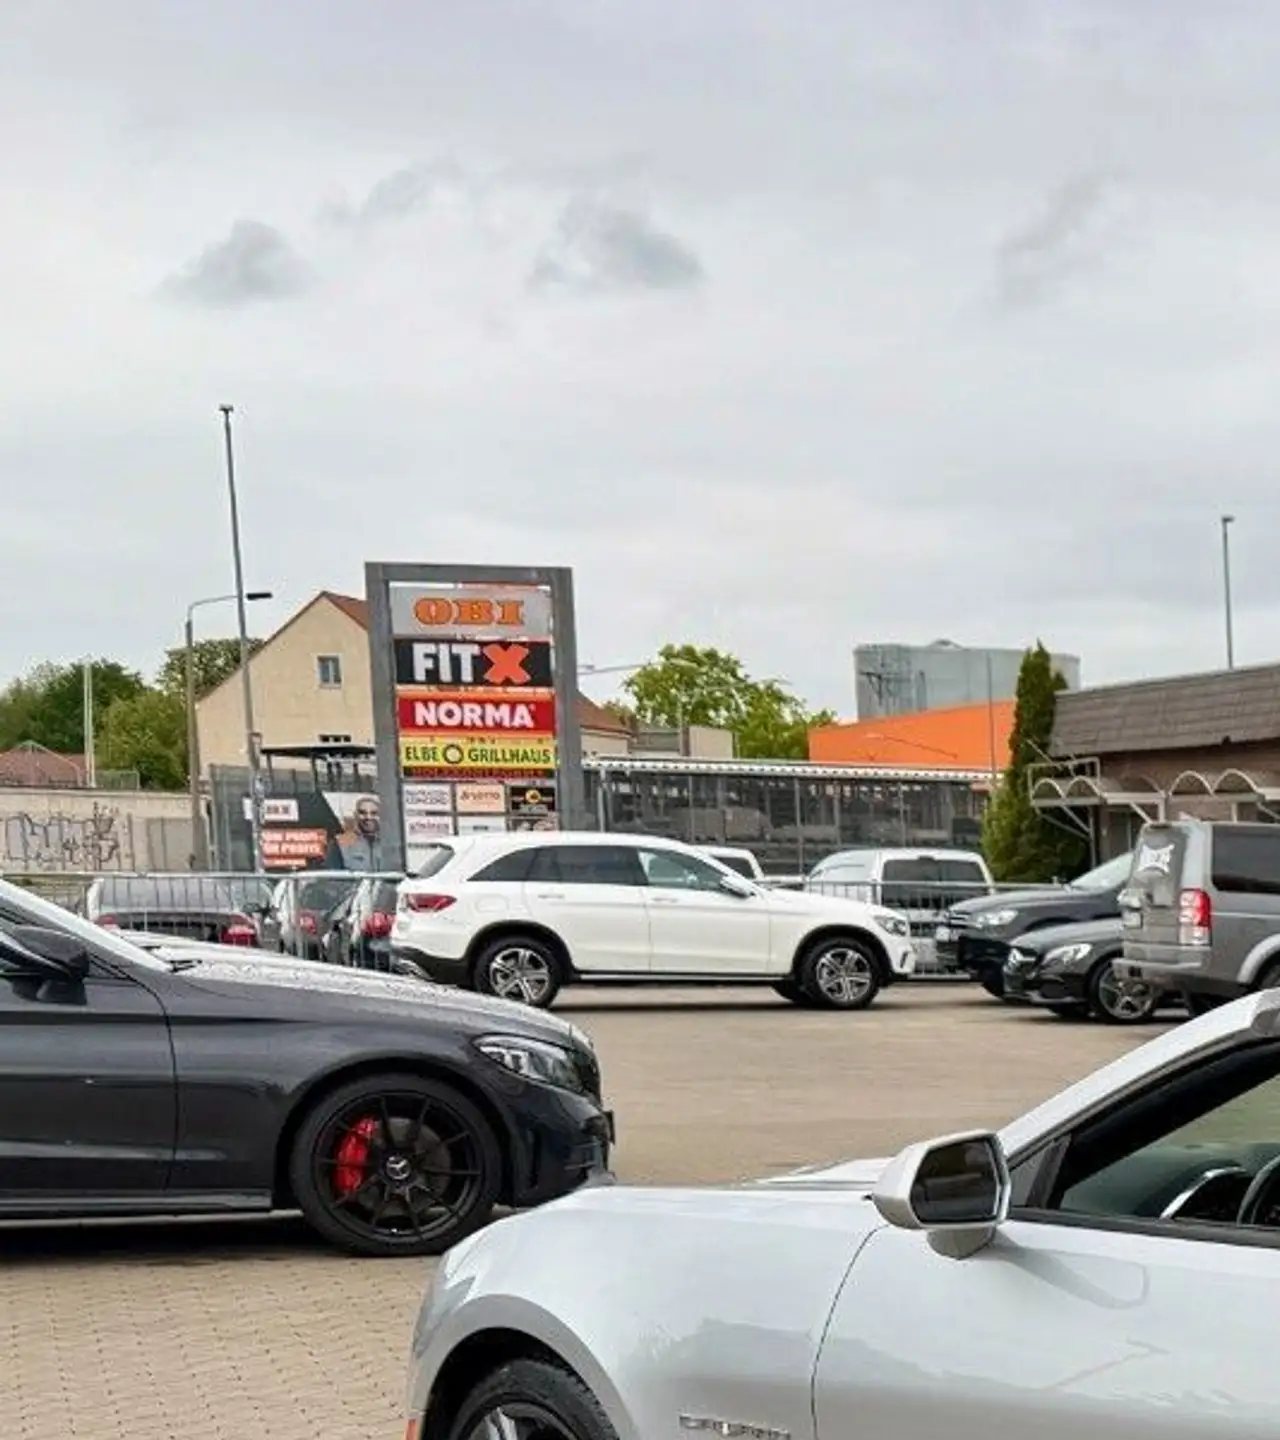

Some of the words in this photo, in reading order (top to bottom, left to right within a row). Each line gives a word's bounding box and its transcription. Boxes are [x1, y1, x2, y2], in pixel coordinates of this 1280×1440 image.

[415, 597, 524, 625] OBI
[413, 700, 536, 728] NORMA
[405, 745, 438, 761] ELBE
[468, 747, 551, 764] GRILLHAUS
